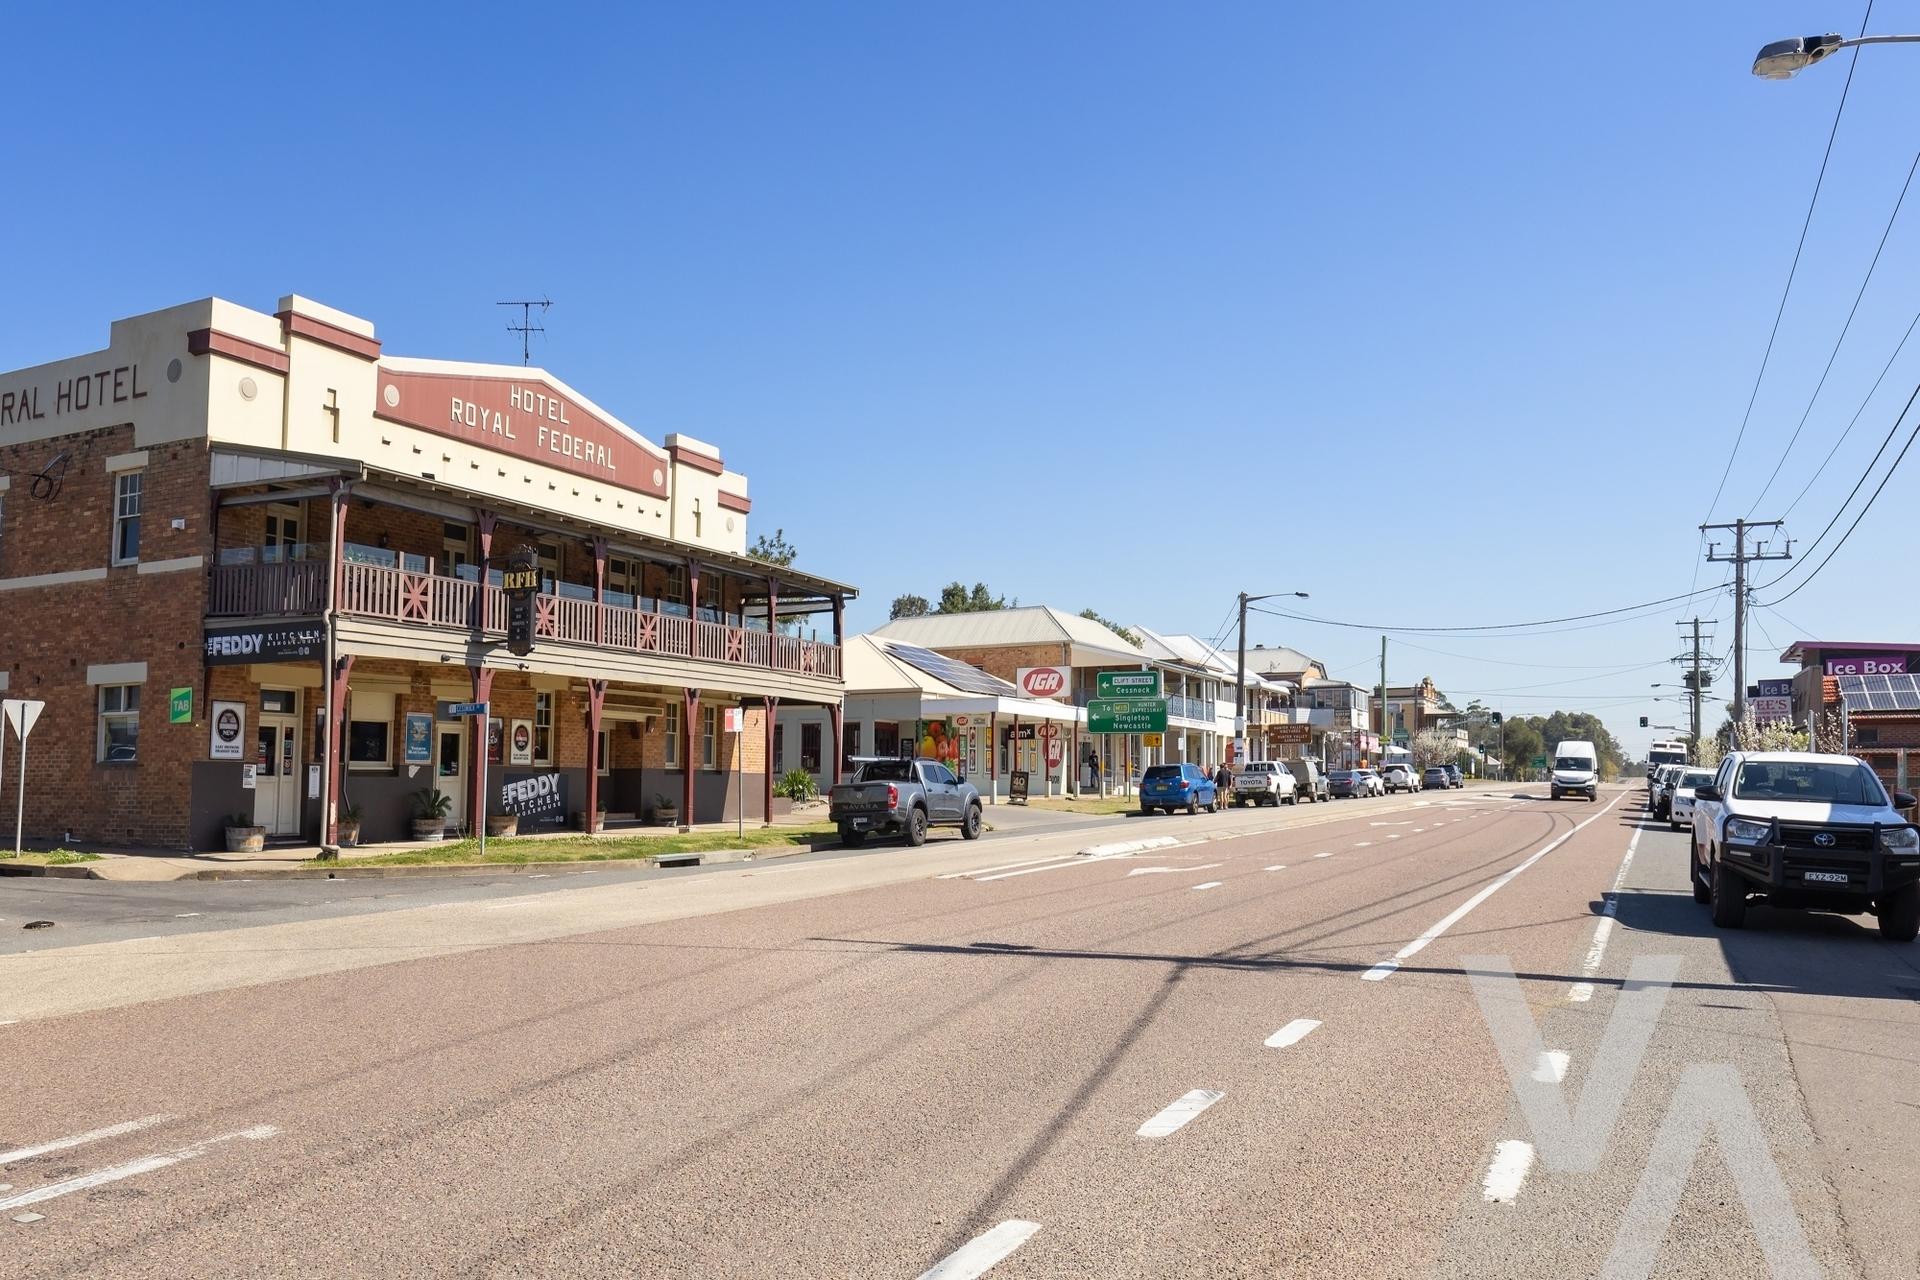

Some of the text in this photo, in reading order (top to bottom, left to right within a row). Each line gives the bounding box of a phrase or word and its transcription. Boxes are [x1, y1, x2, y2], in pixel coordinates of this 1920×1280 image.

[57, 364, 148, 415] HOTEL
[510, 385, 570, 424] HOTEL
[451, 397, 616, 470] ROYAL FEDERAL
[504, 569, 537, 588] RFH
[212, 634, 263, 656] FEDDY
[1827, 660, 1904, 675] Ice Box
[1027, 673, 1061, 691] IGA
[1761, 685, 1778, 695] Ice
[173, 700, 189, 711] TAB
[508, 773, 560, 804] FEDDY
[505, 793, 560, 814] KITCHEN
